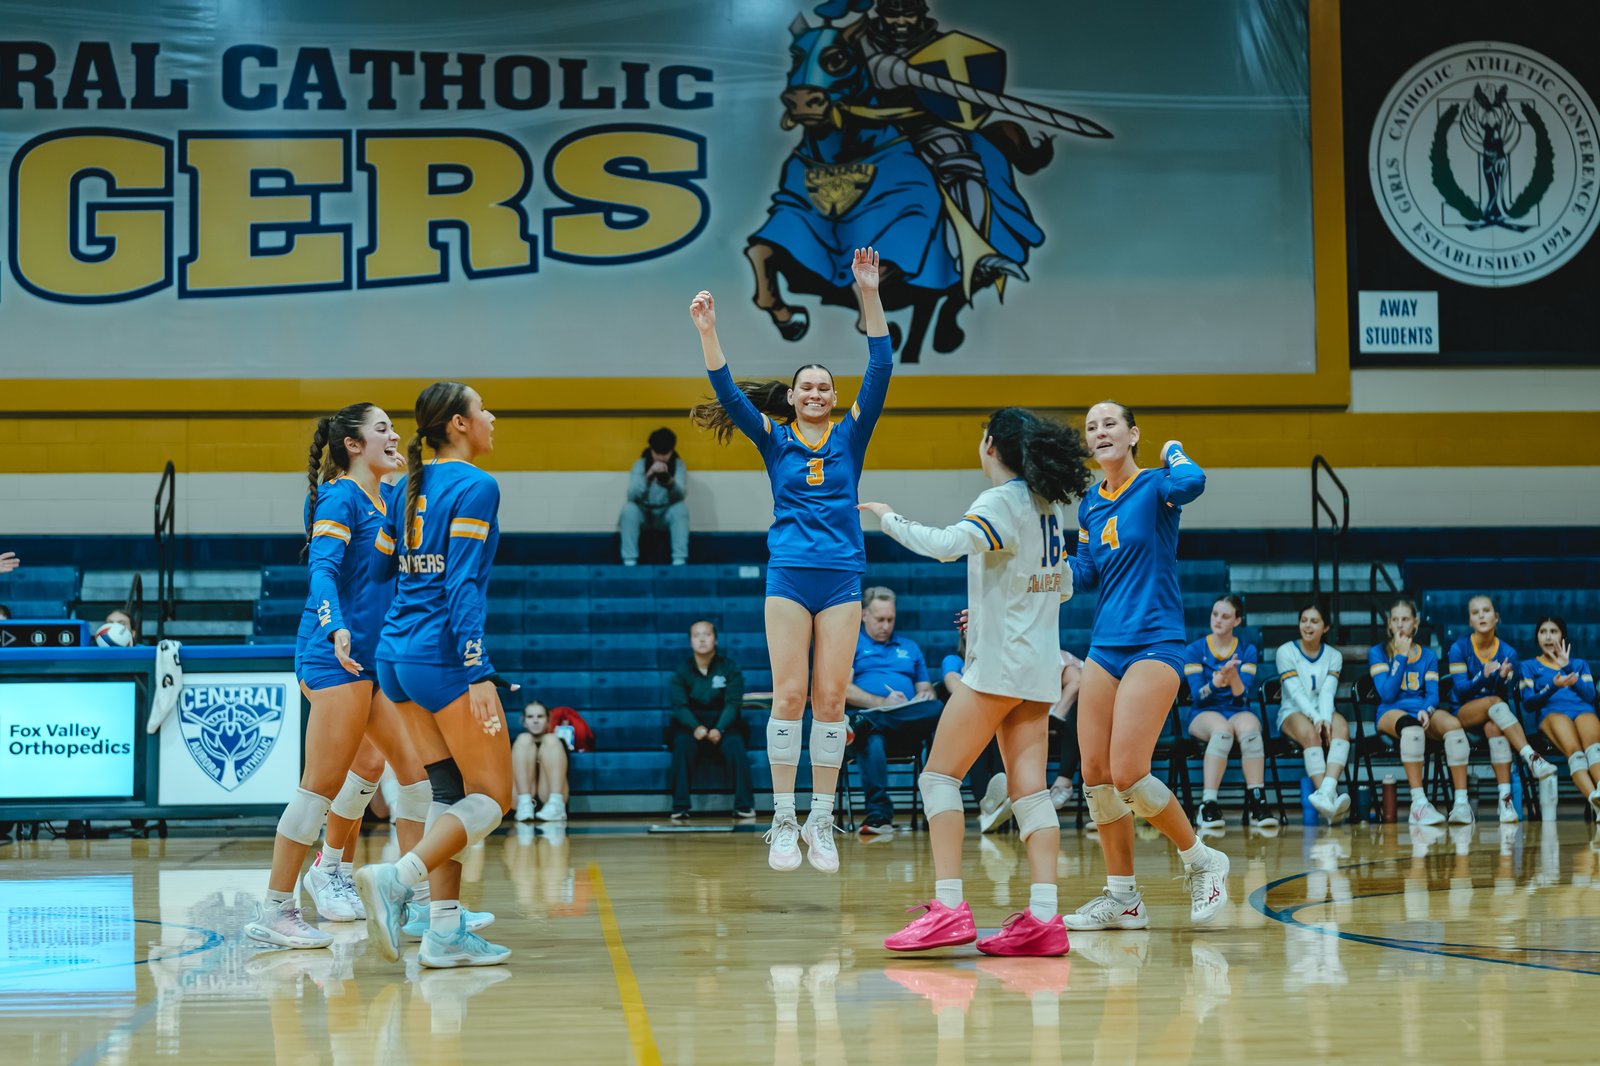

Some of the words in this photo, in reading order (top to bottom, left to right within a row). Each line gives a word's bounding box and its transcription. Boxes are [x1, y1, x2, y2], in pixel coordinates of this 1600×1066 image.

[0, 41, 189, 110] RAL
[221, 44, 714, 111] CATHOLIC
[1465, 55, 1556, 93] ATHLETIC
[1388, 63, 1455, 141] CATHOLIC
[1557, 92, 1595, 217] CONFERENCE
[1386, 157, 1412, 215] GIRLS
[1412, 221, 1537, 271] ESTABLISHED
[1542, 225, 1573, 255] 1974
[1379, 299, 1418, 317] AWAY
[1365, 326, 1433, 345] STUDENTS
[806, 457, 825, 486] 3
[1040, 513, 1061, 568] 16
[1101, 515, 1120, 551] 4
[181, 687, 282, 712] CENTRAL
[1311, 674, 1317, 691] 1
[9, 739, 131, 758] Orthopedics
[10, 724, 41, 737] Fox
[46, 723, 101, 740] Valley
[189, 740, 221, 778] AURORA
[236, 736, 272, 779] CATHOLIC
